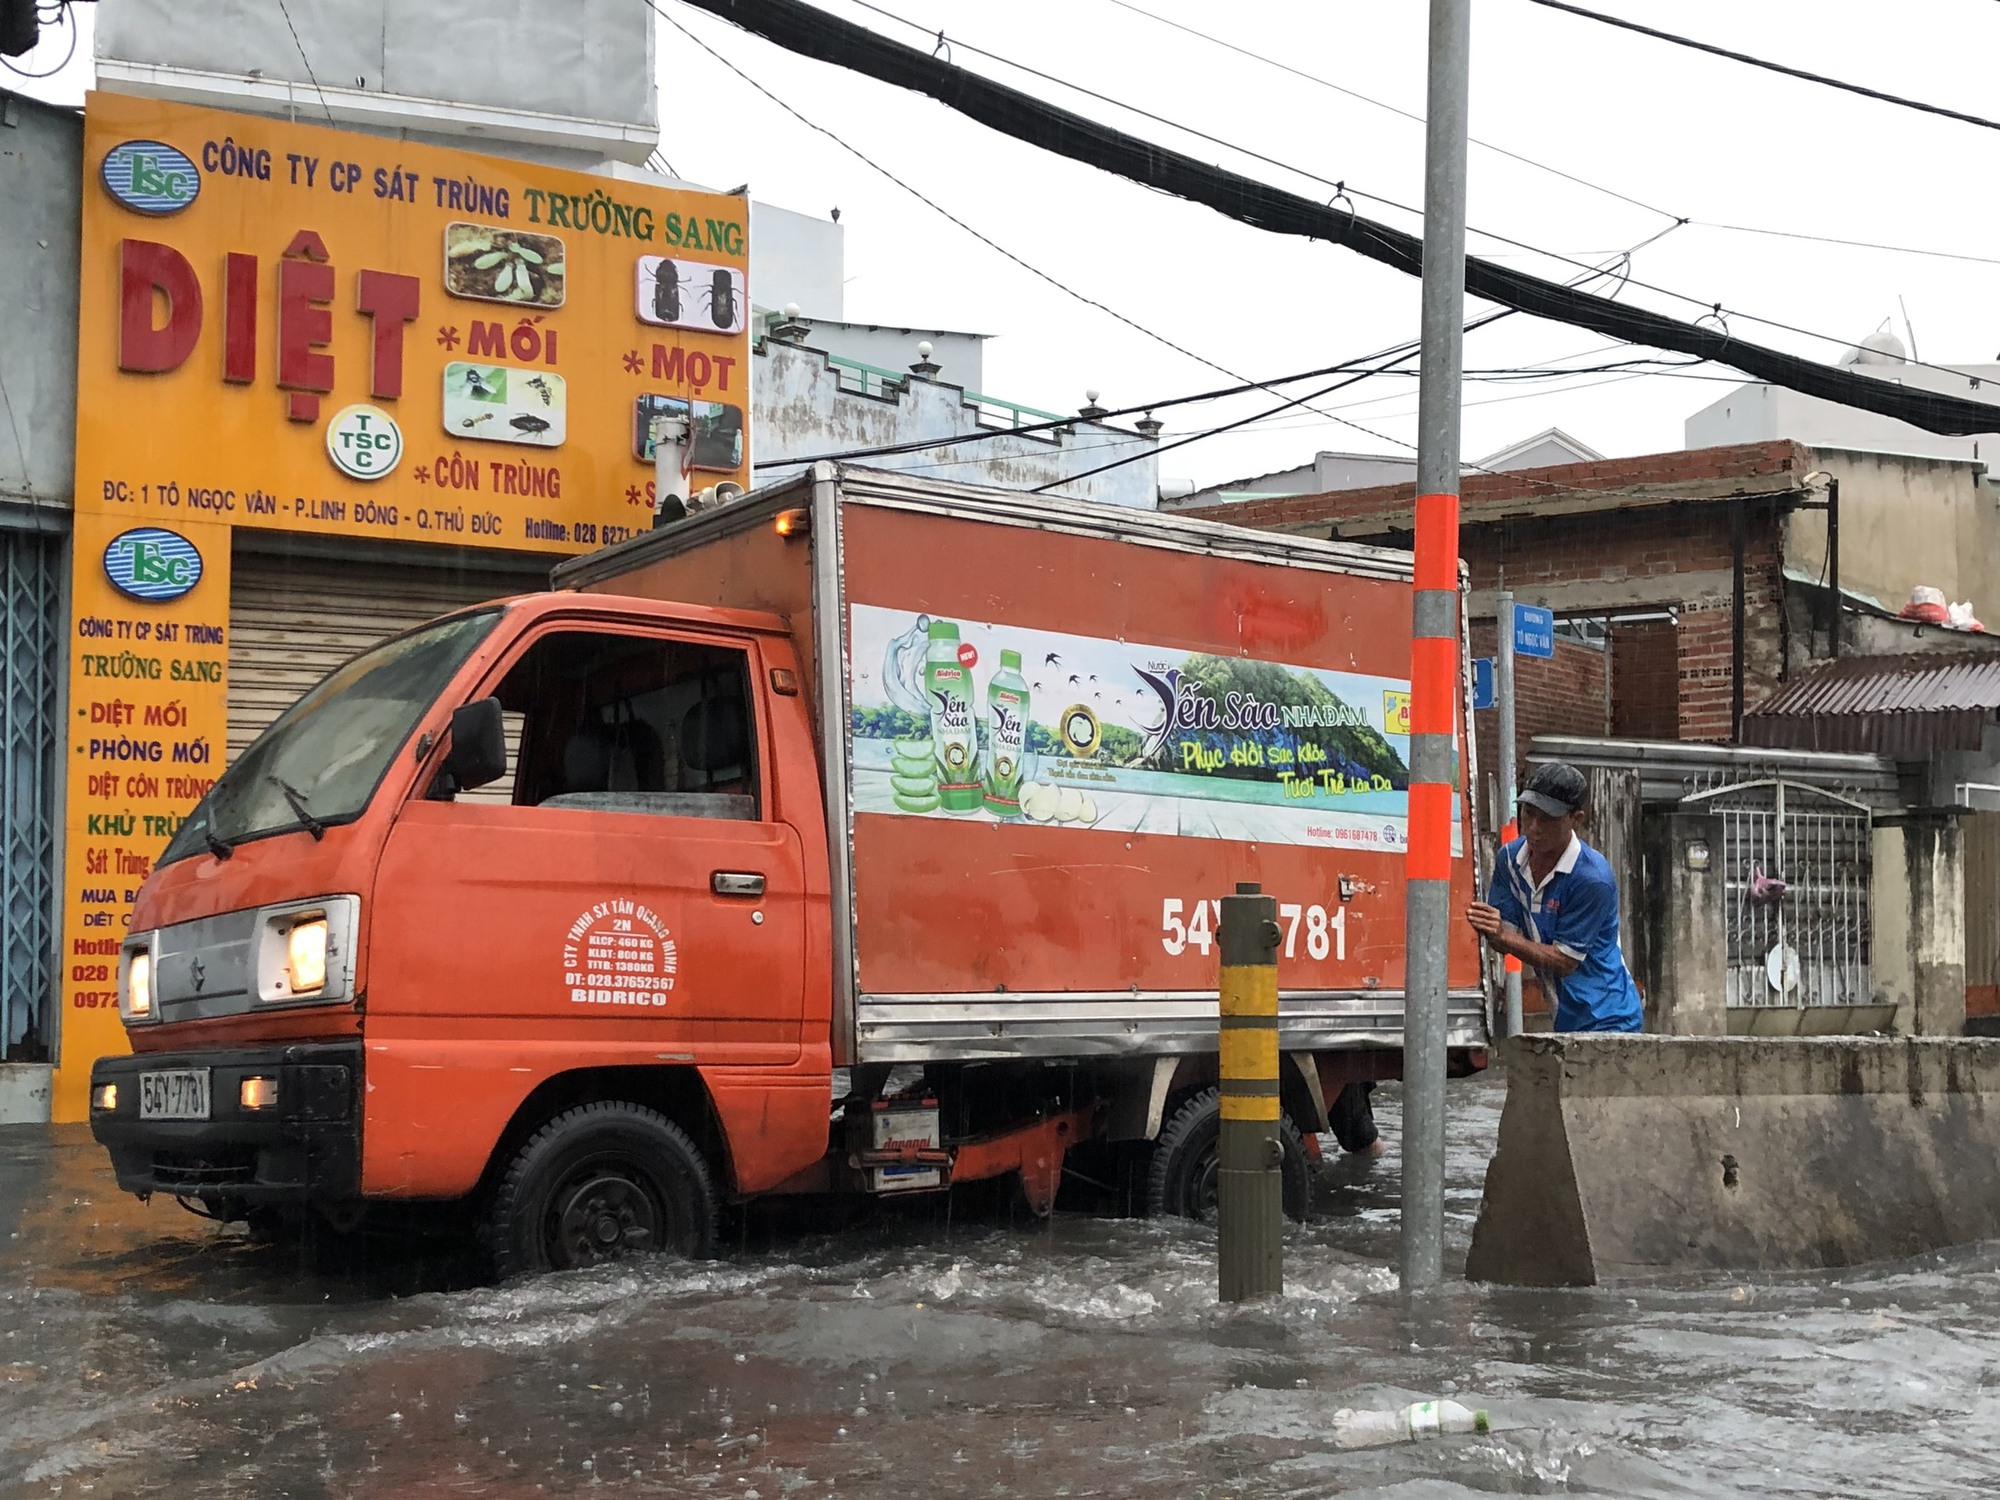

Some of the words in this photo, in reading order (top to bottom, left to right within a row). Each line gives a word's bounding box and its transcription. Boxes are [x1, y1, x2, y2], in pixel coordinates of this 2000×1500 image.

[202, 137, 271, 181] CÔNG
[286, 153, 319, 187] TY
[330, 161, 362, 193] CP
[373, 164, 419, 203] SÁT
[433, 176, 510, 218] TRÙNG
[523, 189, 655, 241] TRƯỜNG
[665, 212, 745, 256] SANG
[117, 229, 421, 423] DIỆT
[467, 316, 558, 366] MỐI
[651, 344, 737, 396] MỌT
[434, 451, 479, 491] CÔN
[490, 459, 561, 499] TRÙNG
[142, 484, 149, 504] 1
[157, 481, 180, 507] TÔ
[188, 487, 236, 515] NGỌC
[245, 490, 277, 514] VÂN
[354, 501, 398, 526] ĐÔNG
[471, 509, 502, 535] ĐỨC
[525, 517, 571, 542] Hotline:
[574, 522, 596, 544] 028
[79, 616, 113, 638] CÔNG
[117, 620, 133, 639] TY
[135, 622, 152, 640] CP
[155, 620, 180, 642] SÁT
[185, 622, 224, 645] TRÙNG
[82, 650, 162, 680] TRƯỜNG
[170, 659, 223, 683] SANG
[91, 698, 136, 728] DIỆT
[144, 699, 188, 727] MỐI
[1222, 690, 1281, 730] Sào
[90, 735, 163, 763] PHÒNG
[172, 736, 210, 763] MỐI
[1180, 741, 1226, 773] Phục
[88, 771, 120, 801] DIỆT
[126, 772, 159, 798] CÔN
[1371, 774, 1394, 792] Da
[88, 809, 136, 836] KHỬ
[86, 847, 108, 875] Sát
[115, 848, 150, 881] Trùng
[81, 889, 117, 904] MUA
[592, 901, 610, 919] SX
[662, 939, 678, 974] MINH
[612, 919, 632, 932] 2N
[639, 939, 654, 949] KG
[639, 951, 654, 962] KG
[72, 965, 108, 982] 028
[571, 988, 668, 1006] BIDRICO
